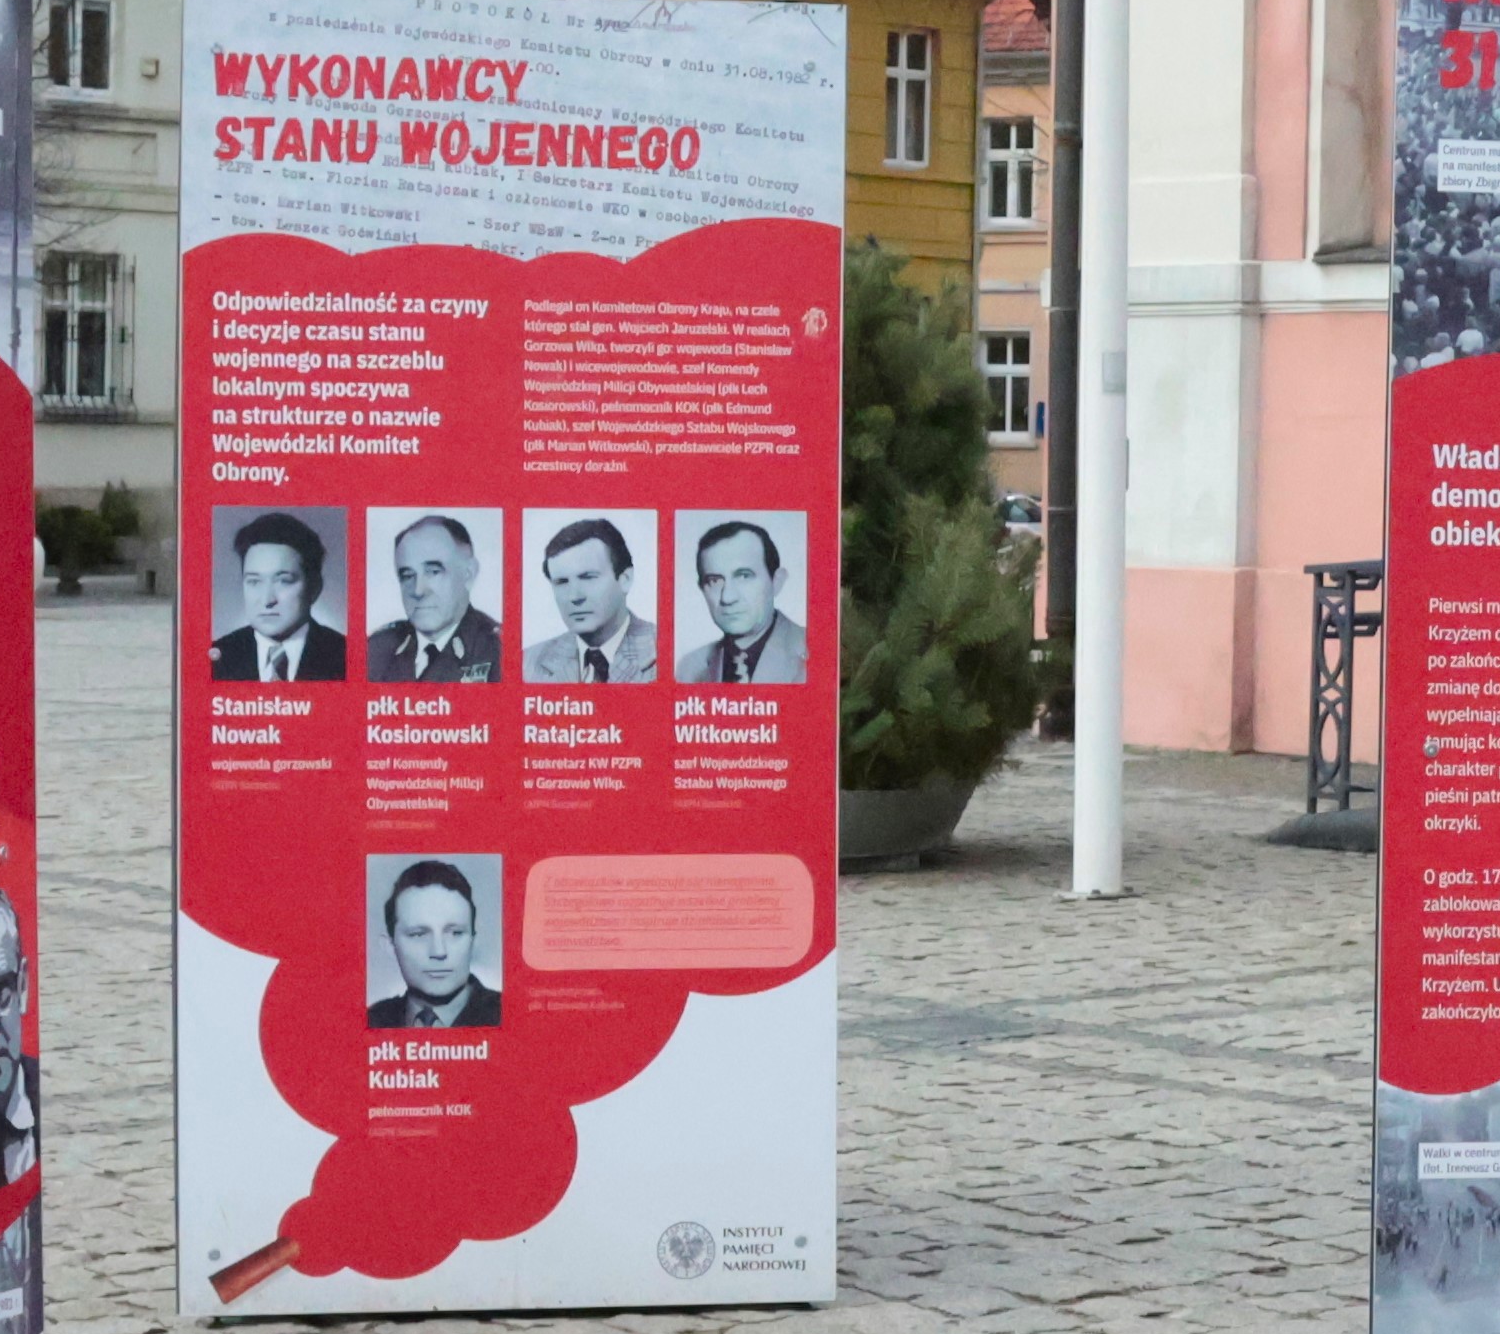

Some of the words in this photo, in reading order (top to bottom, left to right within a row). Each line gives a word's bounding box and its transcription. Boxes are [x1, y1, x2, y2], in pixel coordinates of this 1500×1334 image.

[1440, 30, 1499, 90] 31
[215, 53, 527, 103] WYKONAWCY
[216, 117, 378, 163] STANU
[400, 120, 700, 170] WOJENNEGO
[213, 291, 397, 315] Odpowiedzialność
[403, 298, 425, 313] za
[430, 299, 488, 318] czyny
[213, 319, 219, 338] i
[224, 319, 301, 344] decyzje
[306, 325, 363, 340] czasu
[369, 323, 424, 341] stanu
[213, 348, 322, 373] wojennego
[327, 354, 351, 368] na
[357, 350, 444, 370] szczeblu
[213, 376, 305, 400] lokalnym
[311, 382, 409, 402] spoczywa
[213, 409, 237, 424] na
[242, 405, 346, 425] strukturze
[352, 411, 364, 425] o
[369, 407, 441, 426] nazwie
[213, 432, 334, 457] Wojewódzki
[340, 435, 419, 454] Komitet
[212, 461, 289, 486] Obrony.
[1429, 598, 1482, 614] Pierwsi
[212, 696, 311, 715] Stanisław
[367, 696, 399, 719] płk
[405, 696, 450, 715] Lech
[525, 696, 593, 715] Florian
[675, 696, 705, 720] płk
[711, 697, 777, 715] Marian
[212, 725, 280, 744] Nowak
[367, 724, 488, 744] Kosiorowski
[524, 724, 621, 747] Ratajczak
[675, 724, 777, 743] Witkowski
[369, 1042, 400, 1065] płk
[406, 1041, 488, 1060] Edmund
[369, 1069, 439, 1088] Kubiak
[723, 1227, 782, 1237] INSTYTUT
[723, 1244, 773, 1256] PAMIĘCI
[723, 1260, 805, 1271] NARODOWEJ
